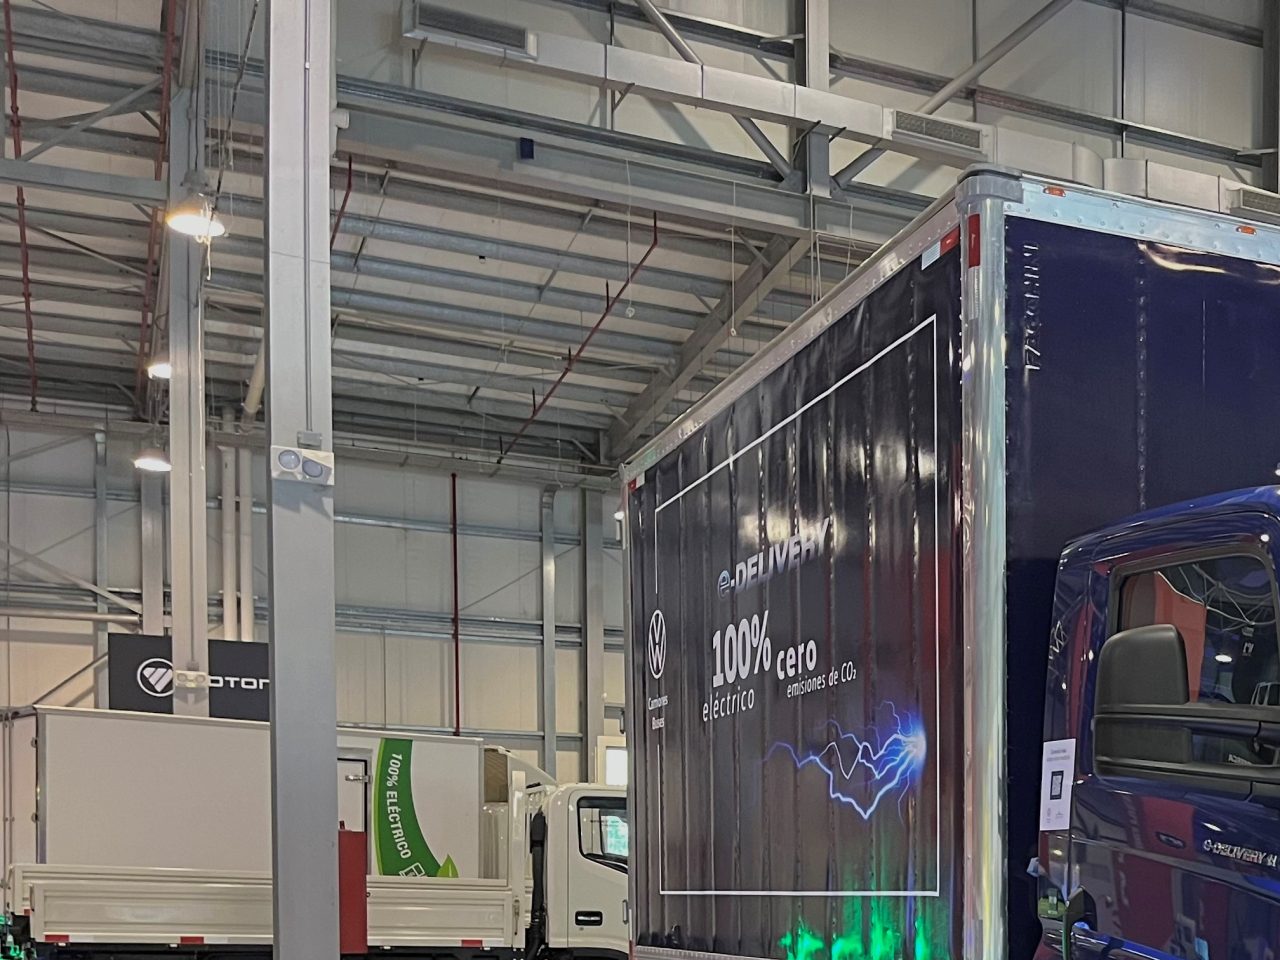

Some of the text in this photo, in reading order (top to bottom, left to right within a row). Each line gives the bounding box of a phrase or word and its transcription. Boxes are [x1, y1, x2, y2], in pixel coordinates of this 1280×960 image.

[717, 517, 831, 599] e-DELIVERY
[712, 610, 817, 688] 100% cero
[786, 675, 826, 699] emisiones
[828, 666, 839, 688] de
[703, 687, 755, 723] eléctrico
[386, 753, 412, 859] 100% ELÉCTRICO
